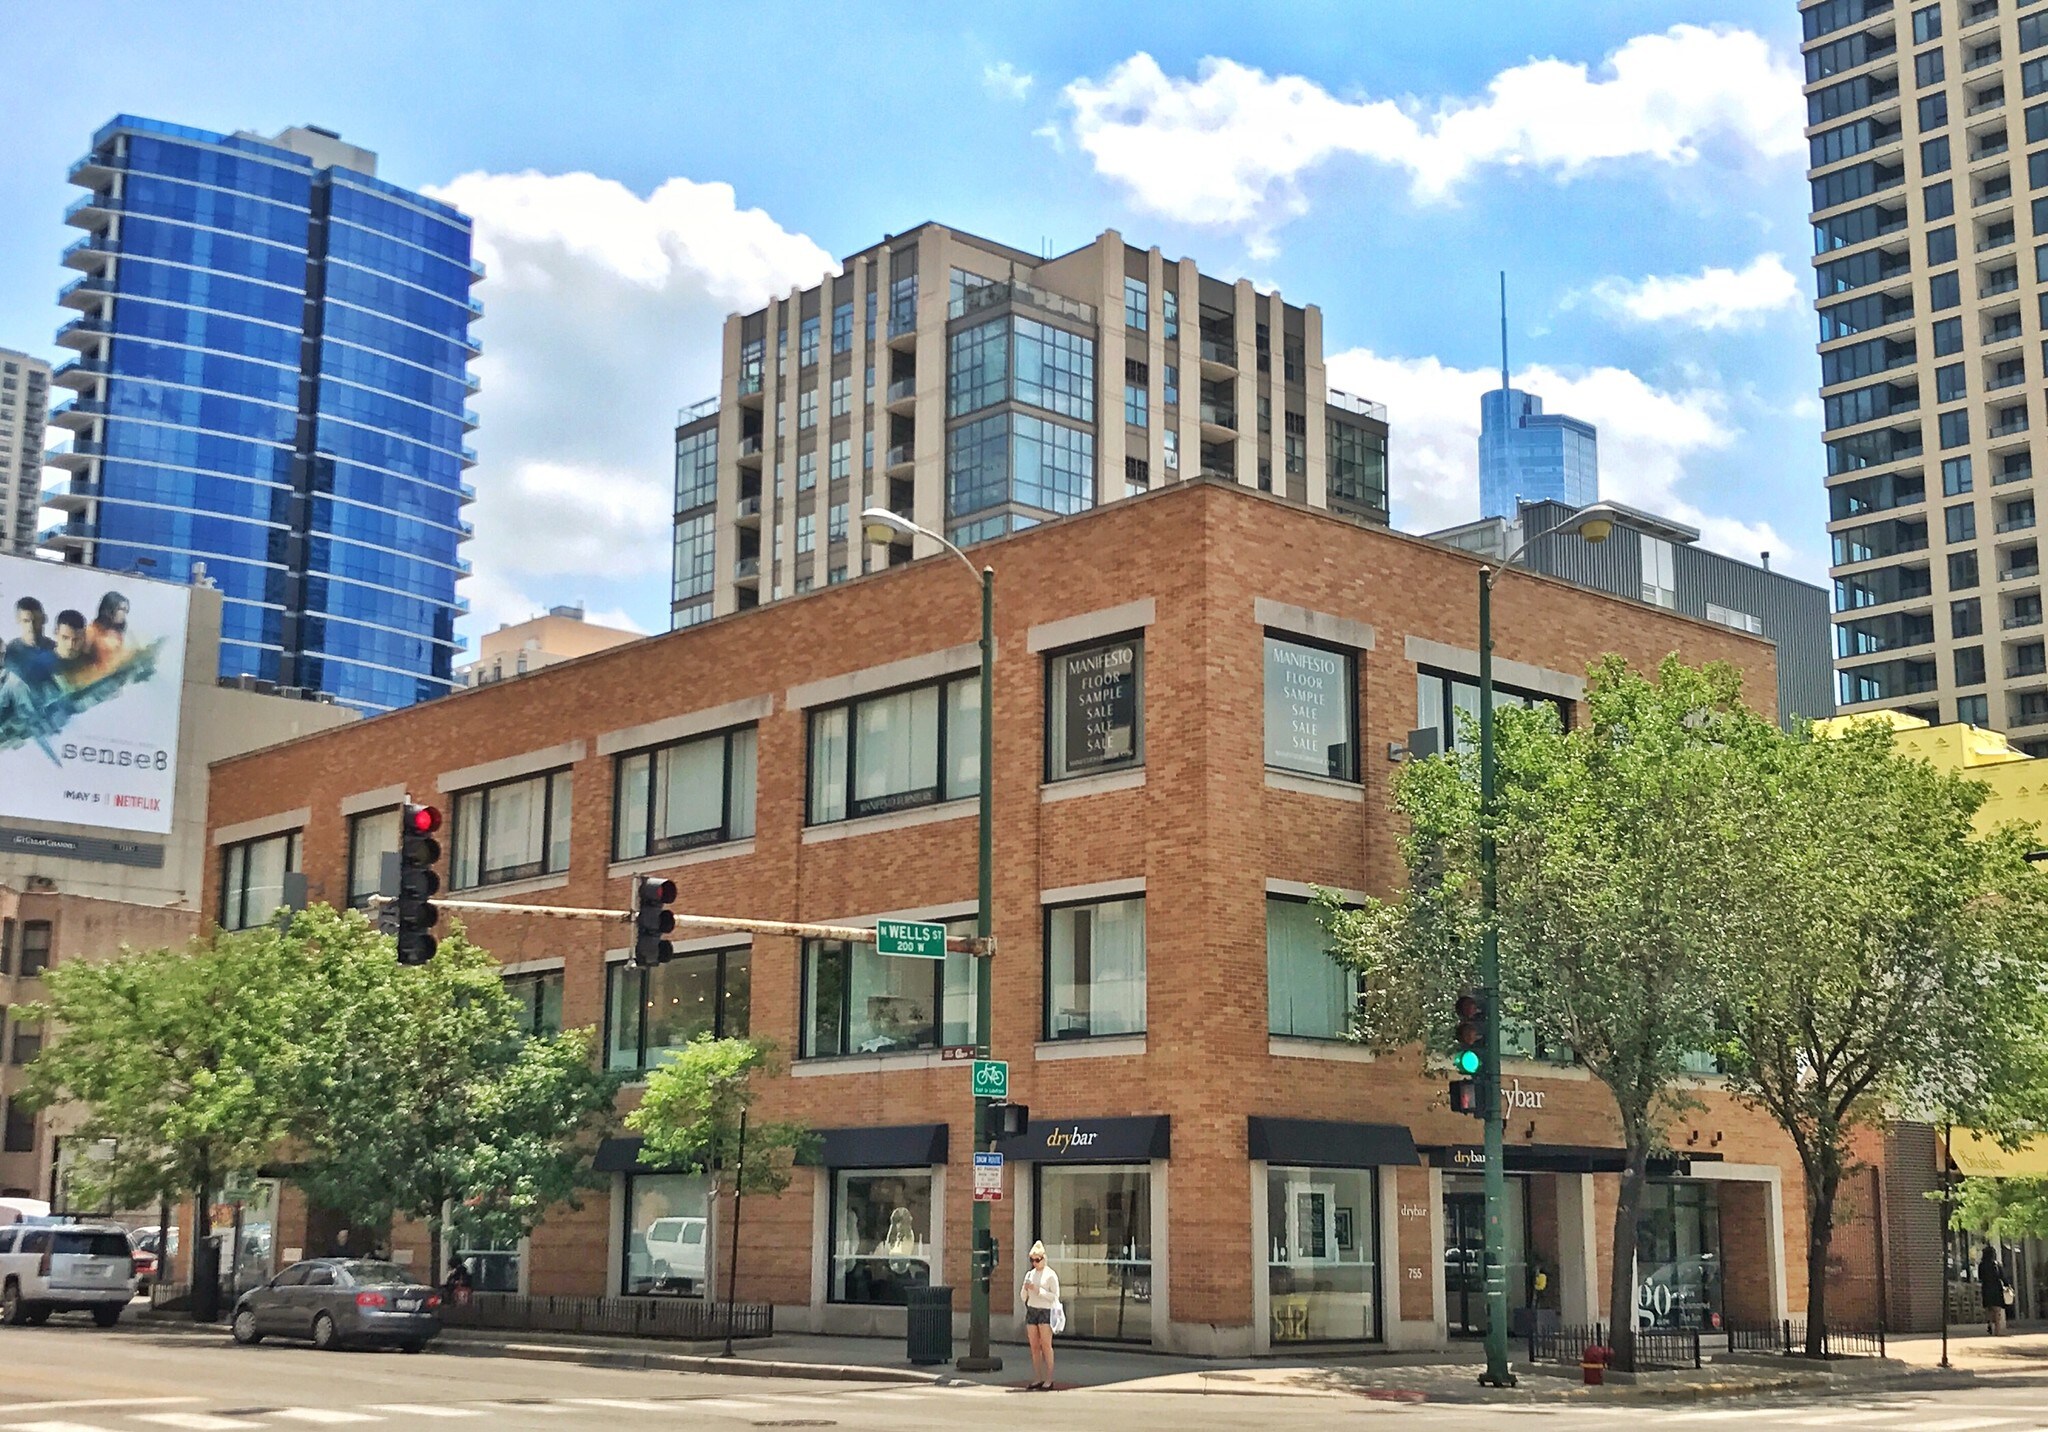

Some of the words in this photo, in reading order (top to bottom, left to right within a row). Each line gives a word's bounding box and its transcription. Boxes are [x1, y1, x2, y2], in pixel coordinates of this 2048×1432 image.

[1069, 647, 1133, 675] MANIFESTO
[1273, 648, 1335, 675] MANIFESTO
[1081, 670, 1120, 690] FLOOR
[1286, 670, 1323, 689] FLOOR
[1079, 685, 1123, 706] SAMPLE
[1284, 686, 1325, 706] SAMPLE
[1086, 703, 1114, 720] SALE
[1292, 703, 1318, 720] SALE
[1086, 719, 1113, 736] SALE
[1292, 719, 1318, 736] SALE
[1086, 735, 1114, 752] SALE
[1292, 736, 1318, 752] SALE
[63, 743, 168, 771] sense8
[64, 790, 91, 802] MAY
[92, 793, 101, 803] 5
[114, 794, 160, 811] NETFLIX
[881, 926, 887, 936] N
[889, 925, 931, 942] WELLS
[932, 930, 942, 940] ST
[897, 941, 914, 952] 200
[917, 943, 925, 952] W
[1501, 1079, 1546, 1120] ybar
[1047, 1126, 1098, 1154] drybar
[1401, 1204, 1427, 1221] drybar
[1408, 1268, 1422, 1279] 755
